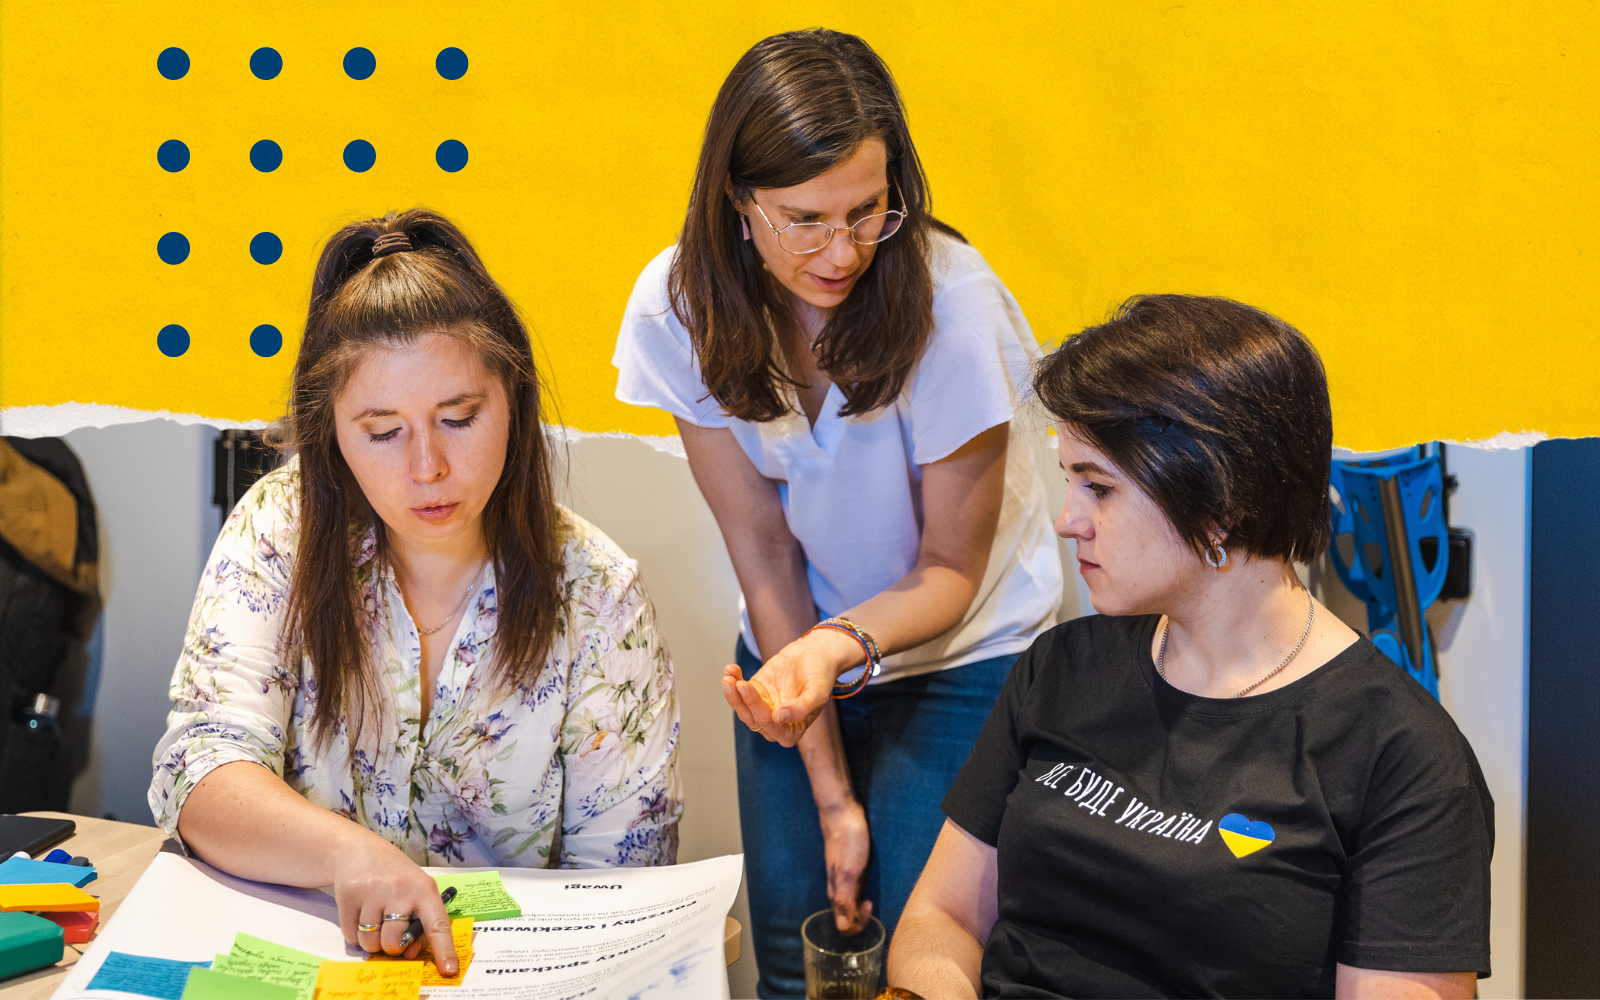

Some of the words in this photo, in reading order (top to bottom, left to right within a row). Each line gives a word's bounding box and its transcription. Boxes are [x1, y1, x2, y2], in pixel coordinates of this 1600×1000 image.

[1064, 767, 1125, 817] БУДЕ
[1115, 796, 1214, 845] УКРАЇНА
[611, 901, 697, 927] Potrzeby
[472, 925, 596, 933] oczekiwania
[485, 960, 590, 976] spotkania
